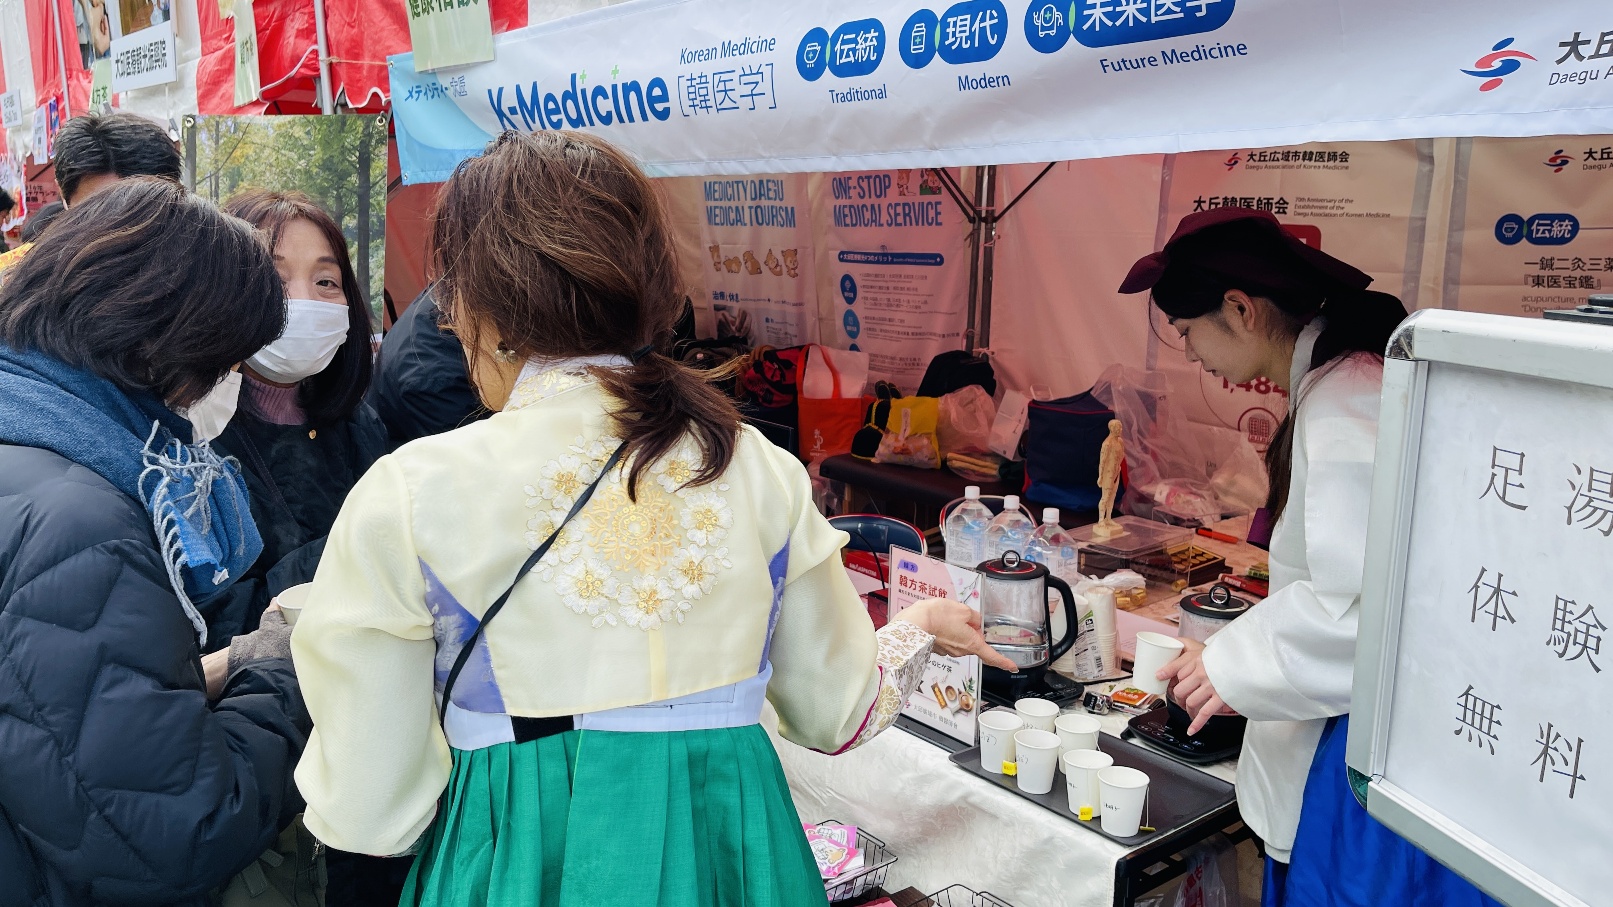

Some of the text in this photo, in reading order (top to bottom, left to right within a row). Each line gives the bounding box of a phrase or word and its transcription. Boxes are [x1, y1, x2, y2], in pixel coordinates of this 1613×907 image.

[944, 11, 999, 50] 現代
[680, 36, 776, 65] Korean Medicine
[834, 27, 878, 66] 伝統
[1100, 42, 1248, 74] Future Medicine
[958, 72, 1011, 92] Modern
[1549, 69, 1600, 86] Daegu
[487, 66, 671, 131] K-Medicine
[829, 84, 887, 104] Traditional
[1246, 151, 1350, 163] 大丘広域市韓医師会
[1583, 146, 1613, 162] 大丘
[1583, 163, 1607, 171] Daegu
[704, 179, 784, 202] MEDICITY DAEGU
[832, 174, 891, 200] ONE-STOP
[706, 205, 748, 227] MEDICAL
[834, 201, 943, 228] MEDICAL SERVICE
[1531, 219, 1573, 239] 伝統
[1522, 295, 1576, 304] acupuncture,
[1467, 565, 1608, 674] 体験
[1453, 684, 1587, 800] 無料
